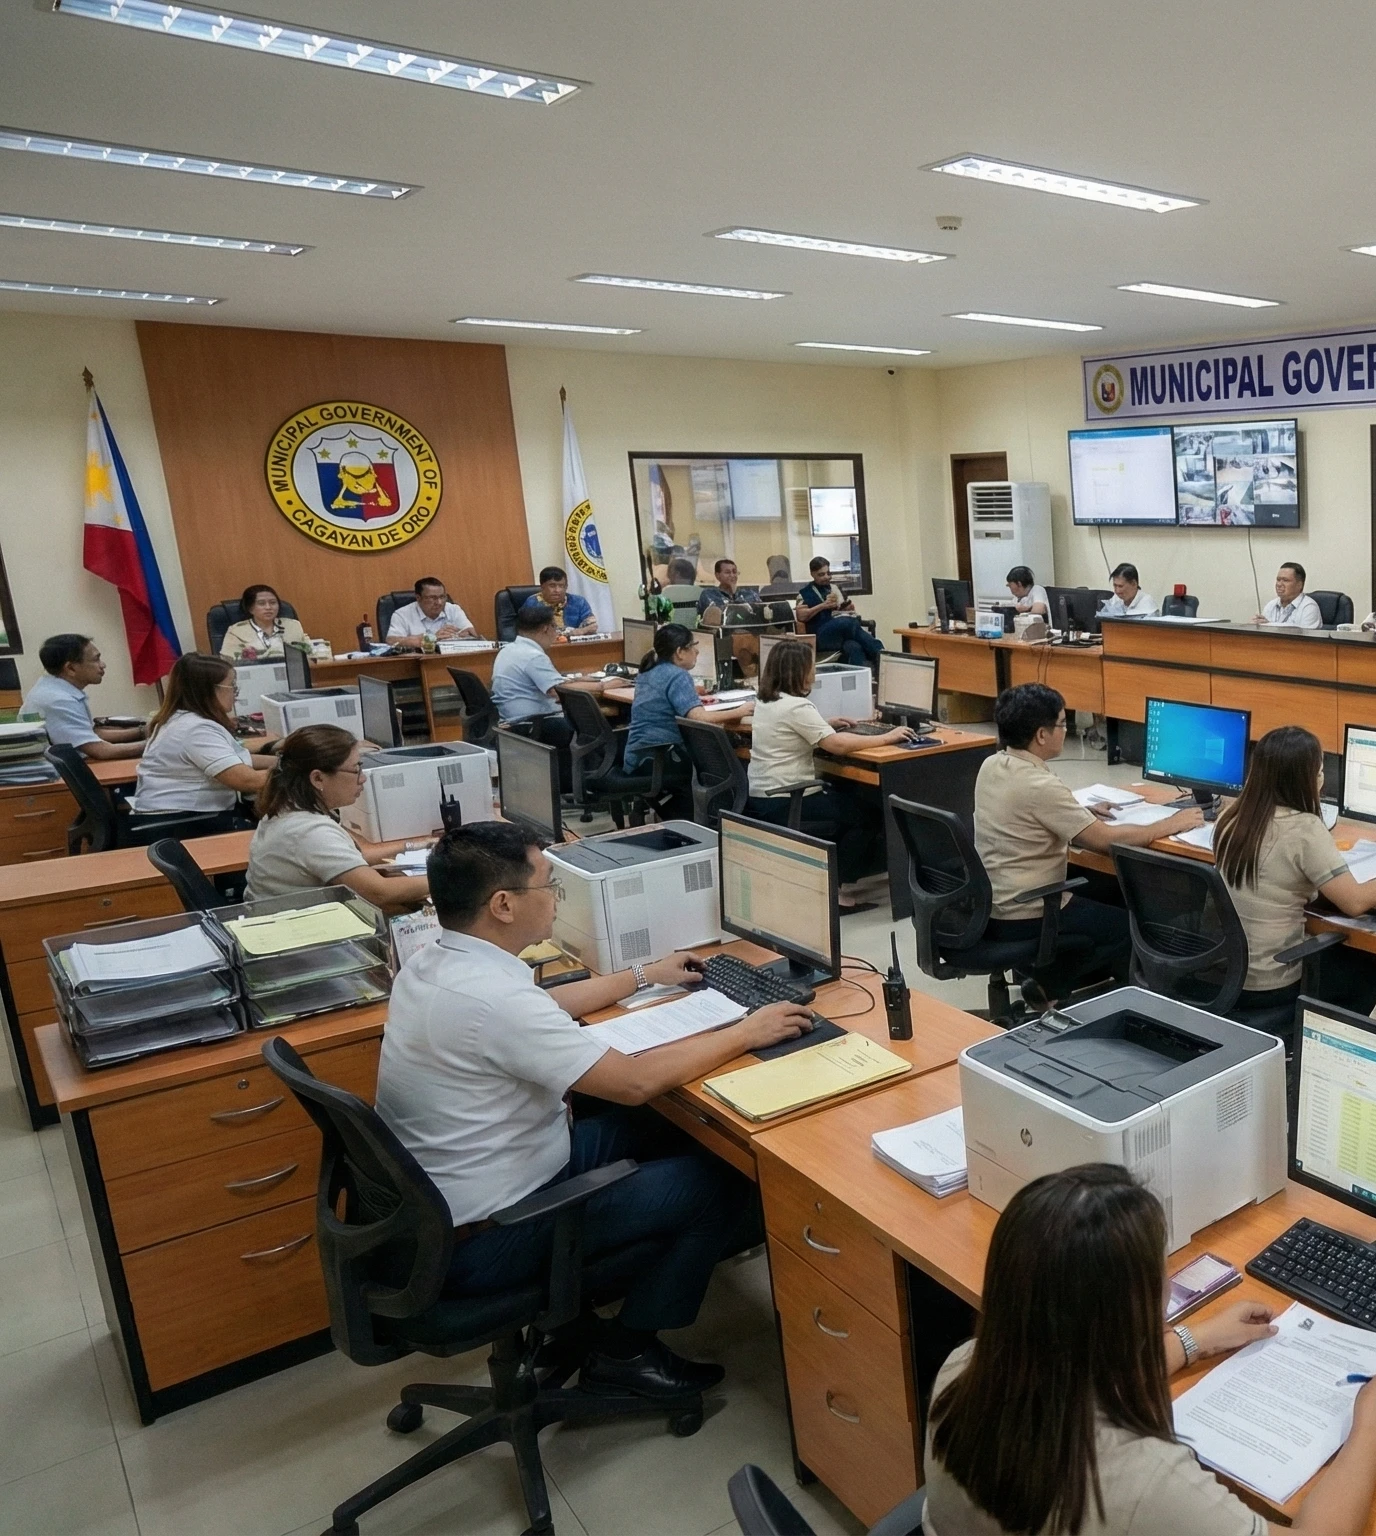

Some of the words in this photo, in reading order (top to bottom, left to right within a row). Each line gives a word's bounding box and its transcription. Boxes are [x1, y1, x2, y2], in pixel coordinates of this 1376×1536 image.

[1130, 354, 1274, 406] MUNICIPAL
[273, 416, 318, 492] MUNICIPAL
[320, 405, 433, 466] GOVERNMENT
[423, 469, 438, 490] OF
[292, 508, 373, 548] CAGAYAN
[378, 527, 402, 546] DE
[402, 505, 431, 535] ORO
